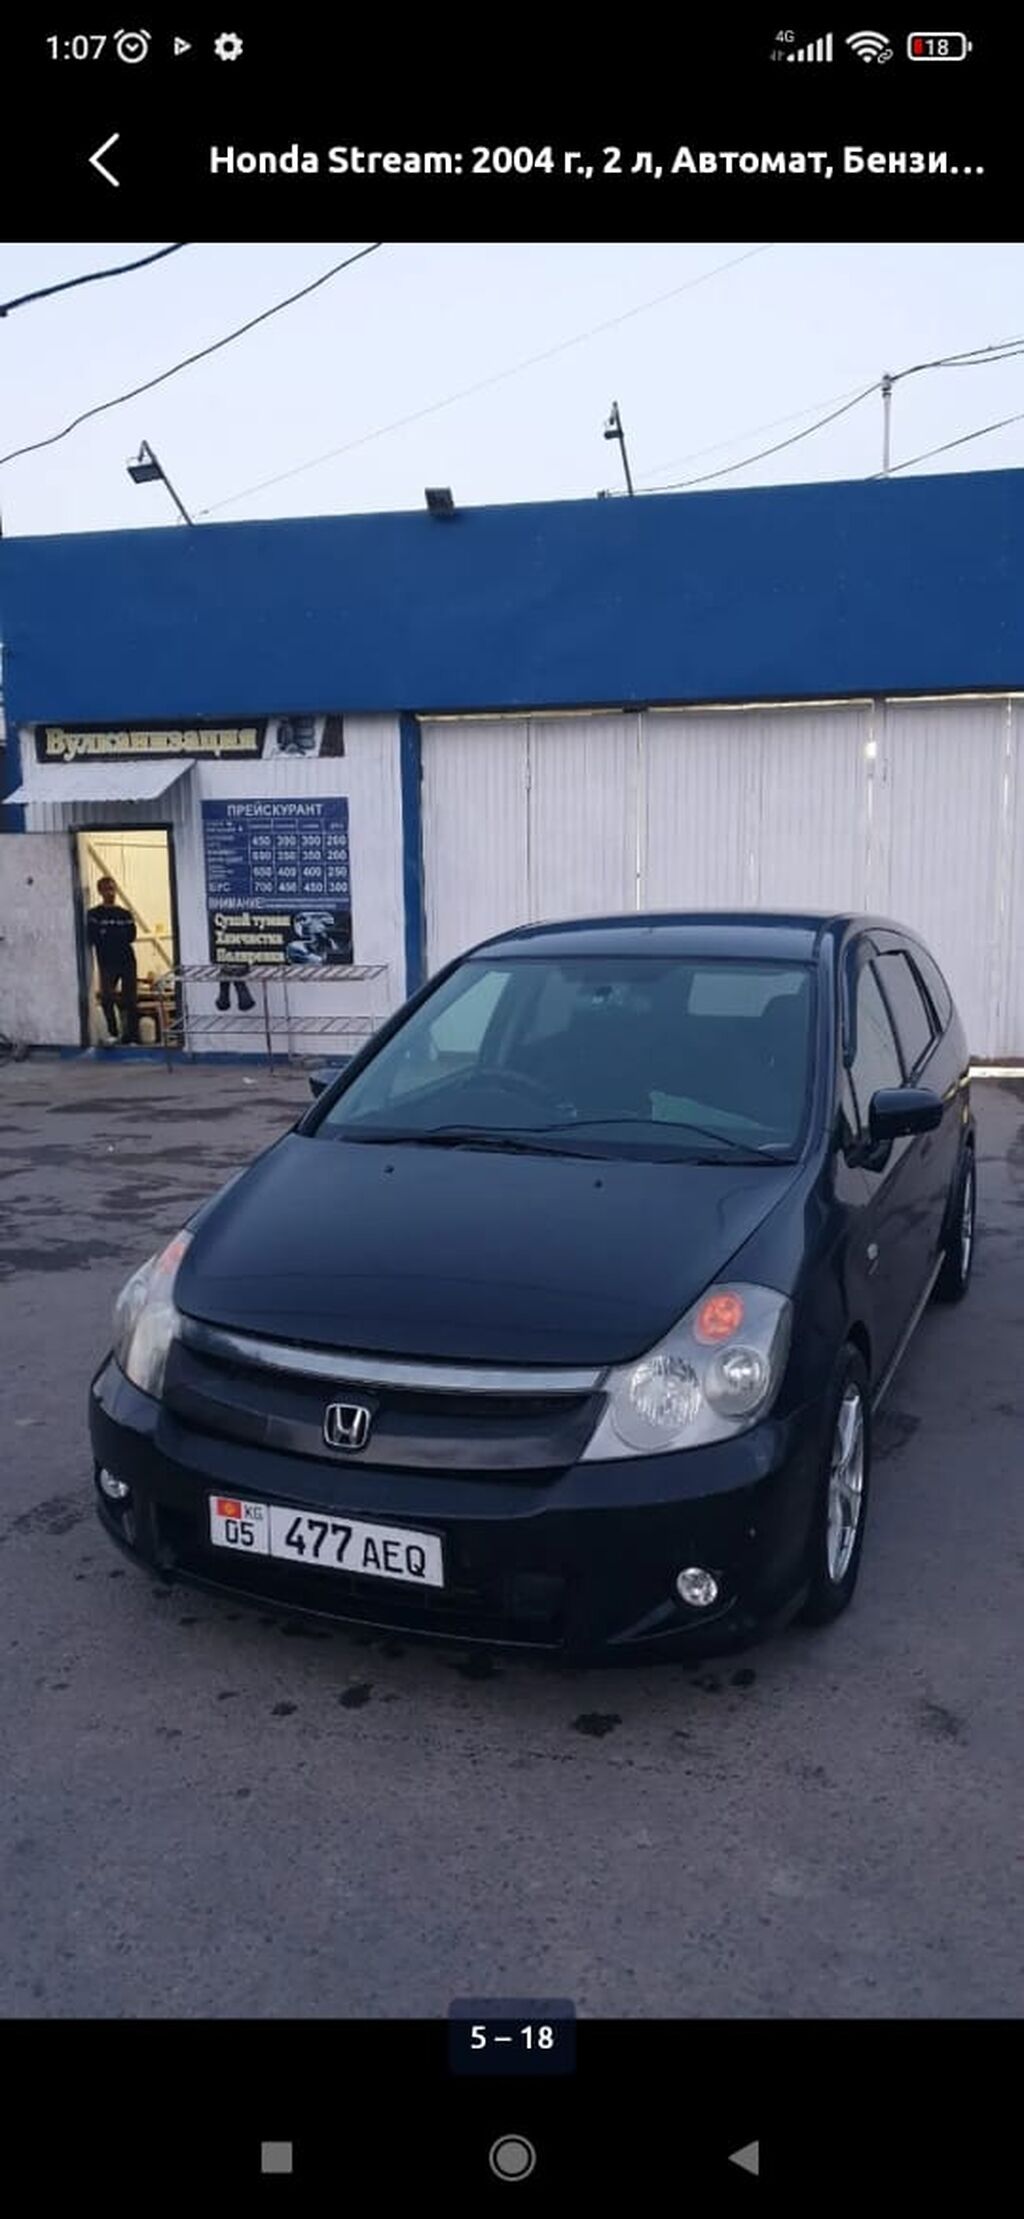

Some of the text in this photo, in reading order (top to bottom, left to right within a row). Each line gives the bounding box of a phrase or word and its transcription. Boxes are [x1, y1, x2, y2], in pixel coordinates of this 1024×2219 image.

[46, 728, 258, 761] Вулканизация
[227, 801, 323, 817] ПРЕЙСКУРАНТ
[303, 866, 322, 877] 400
[214, 930, 284, 945] Химчистка
[216, 948, 286, 964] Полировка
[243, 1503, 264, 1521] KG
[224, 1516, 427, 1578] 05 477 AEQ
